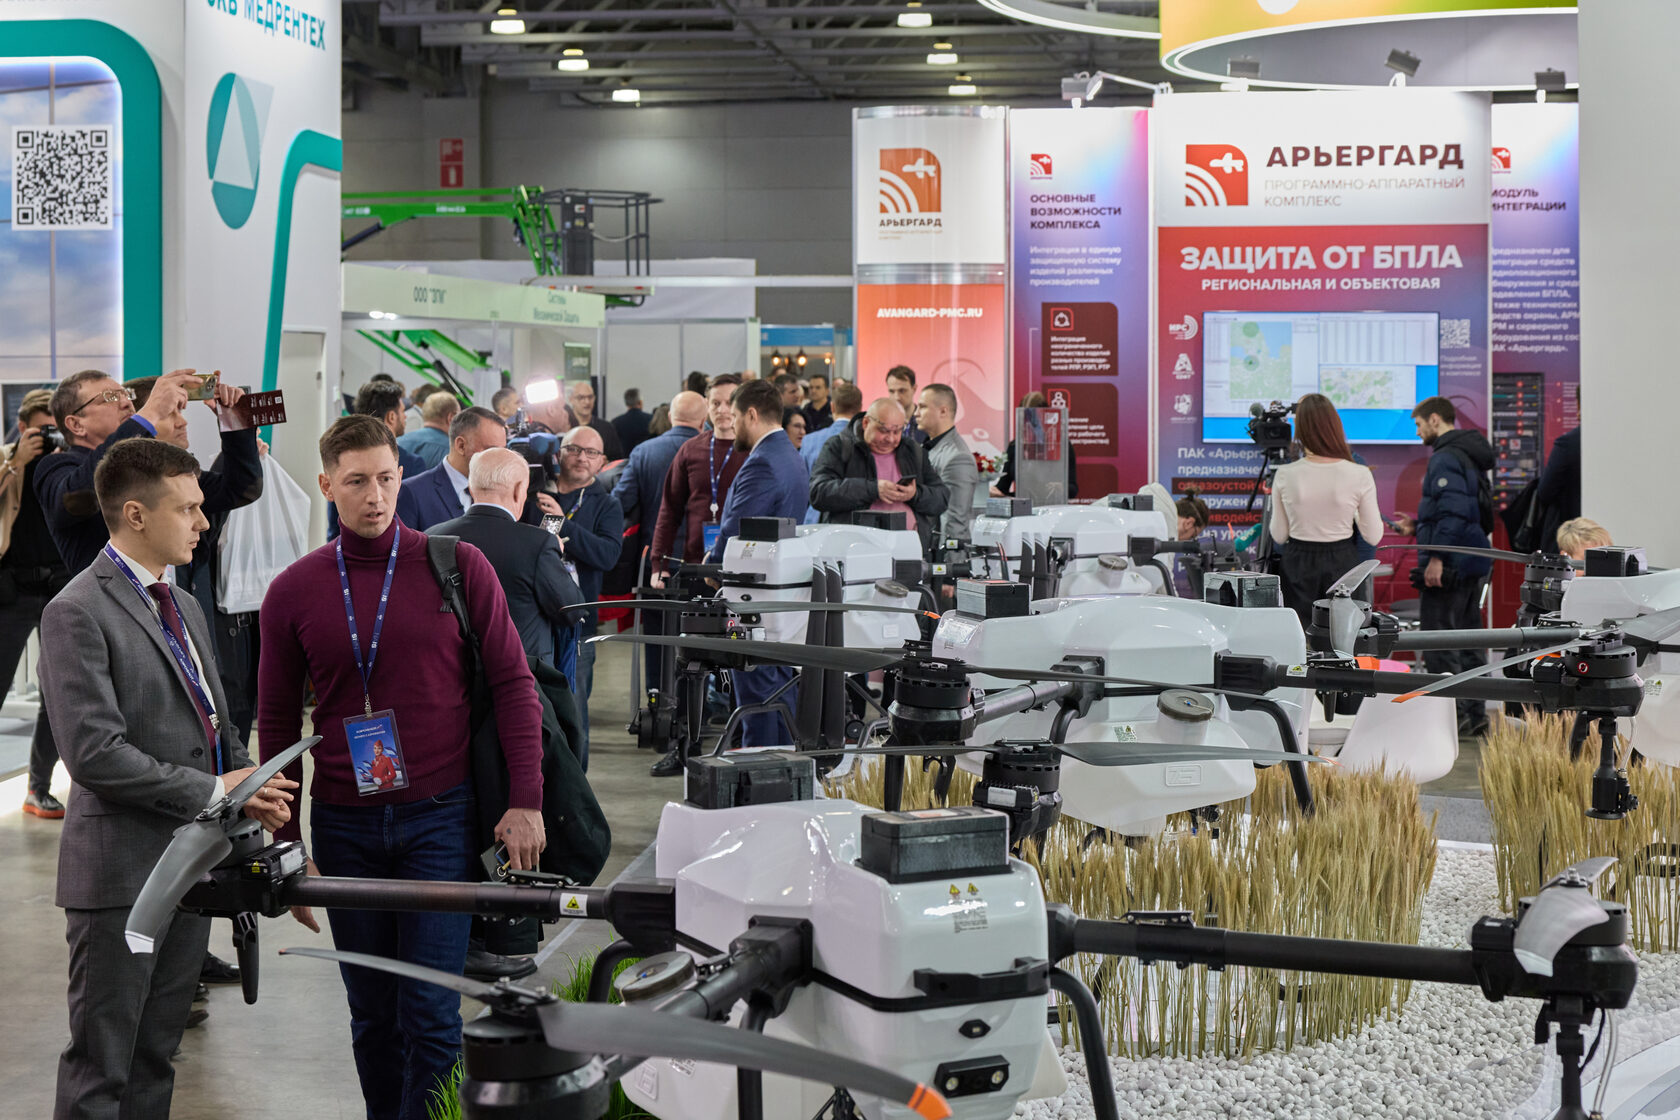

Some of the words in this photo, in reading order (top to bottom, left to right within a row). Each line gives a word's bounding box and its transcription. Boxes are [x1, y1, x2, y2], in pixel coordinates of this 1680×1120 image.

[244, 0, 326, 51] МЕДРЕНТЕХ
[1266, 143, 1465, 170] АРЬЕРГАРД
[1264, 177, 1465, 191] ПРОГРАММНО-АППАРАТНЫЙ
[1030, 194, 1096, 203] ОСНОВНЫЕ
[1264, 195, 1342, 208] КОМПЛЕКС
[1030, 207, 1122, 216] ВОЗМОЖНОСТИ
[879, 218, 943, 227] АРЬЕРГАРД
[1030, 220, 1101, 229] КОМПЛЕКСА
[1180, 246, 1317, 273] ЗАЩИТА
[1323, 246, 1366, 269] ОТ
[1373, 245, 1463, 269] БПЛА
[1201, 278, 1322, 291] РЕГИОНАЛЬНАЯ
[1325, 278, 1337, 290] И
[1340, 277, 1440, 290] ОБЪЕКТОВАЯ
[877, 308, 983, 318] AVANGARD-PMC.RU
[1178, 448, 1205, 459] ПАК
